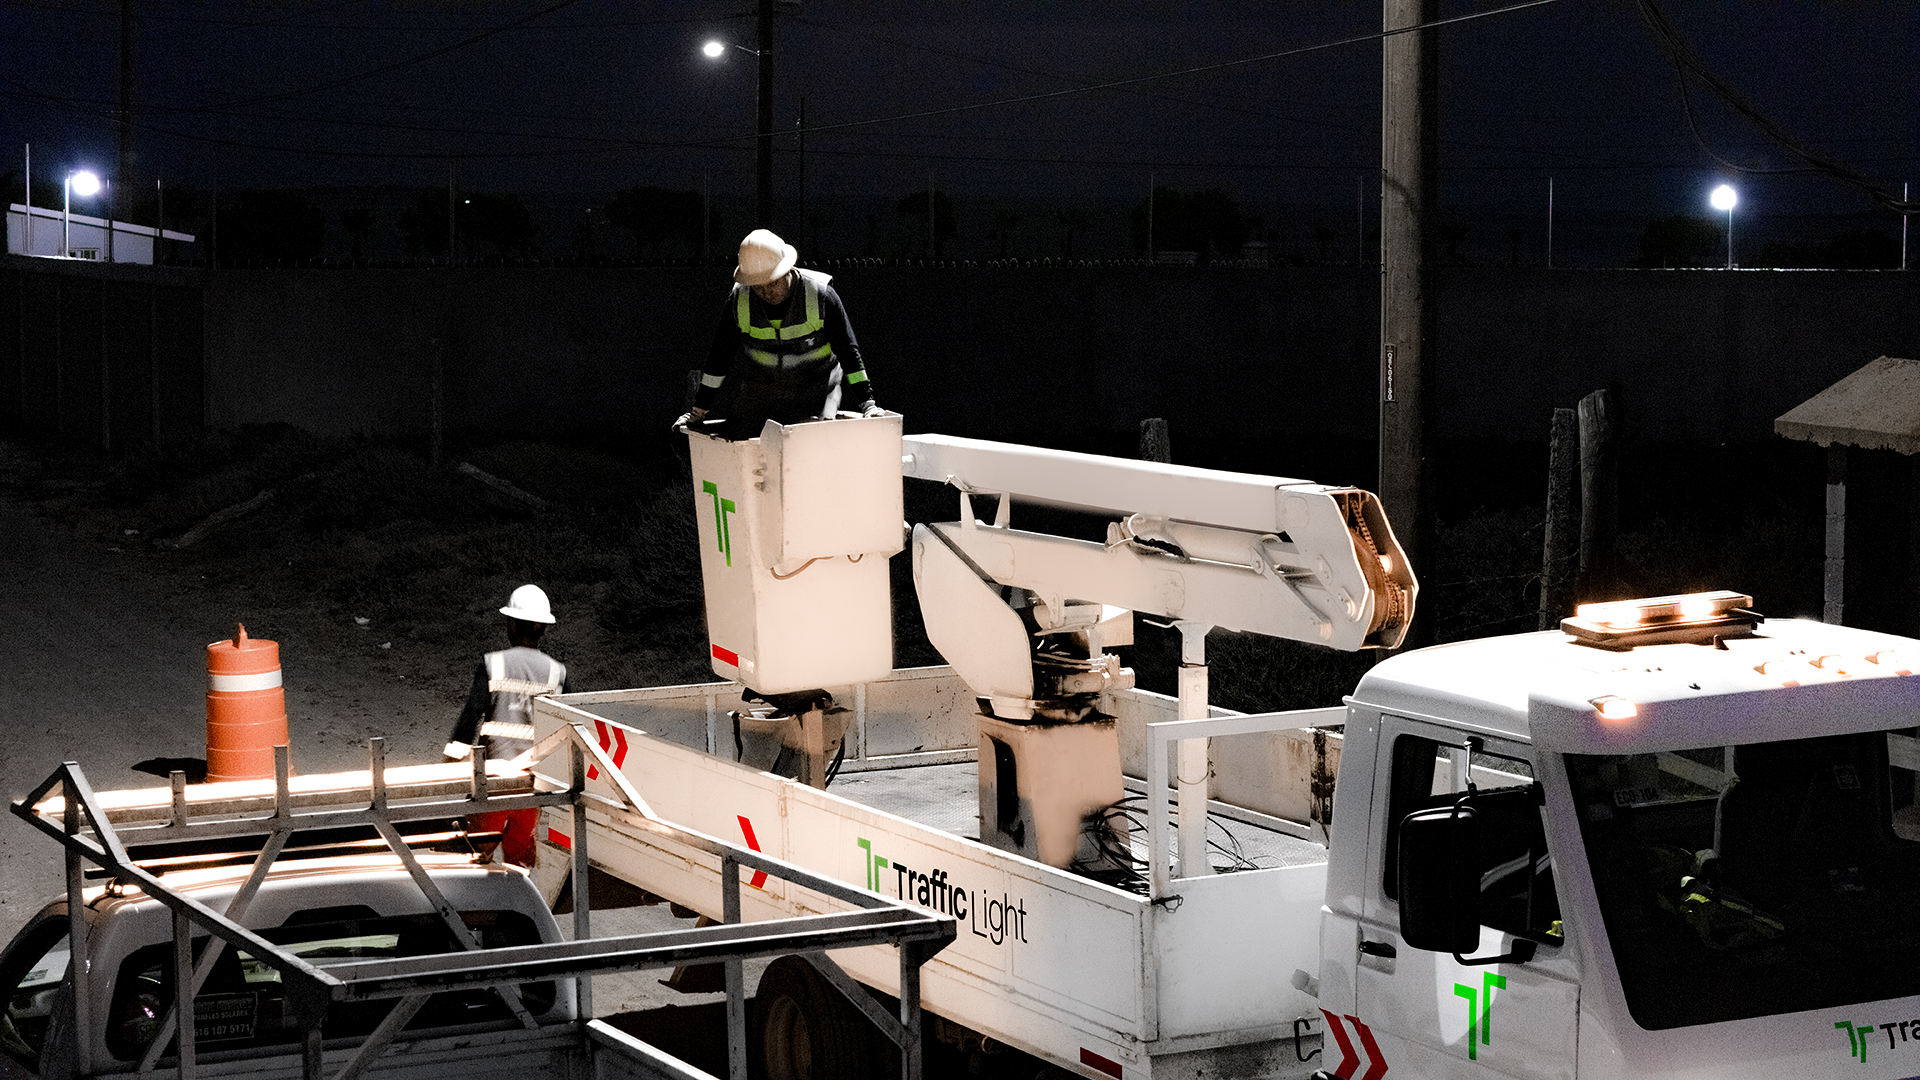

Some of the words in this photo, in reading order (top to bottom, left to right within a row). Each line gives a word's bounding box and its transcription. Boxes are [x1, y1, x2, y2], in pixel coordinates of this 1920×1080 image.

[1616, 788, 1659, 804] ECO-104
[893, 862, 967, 920] Traffic
[971, 889, 1028, 946] Light
[212, 1025, 227, 1035] 107
